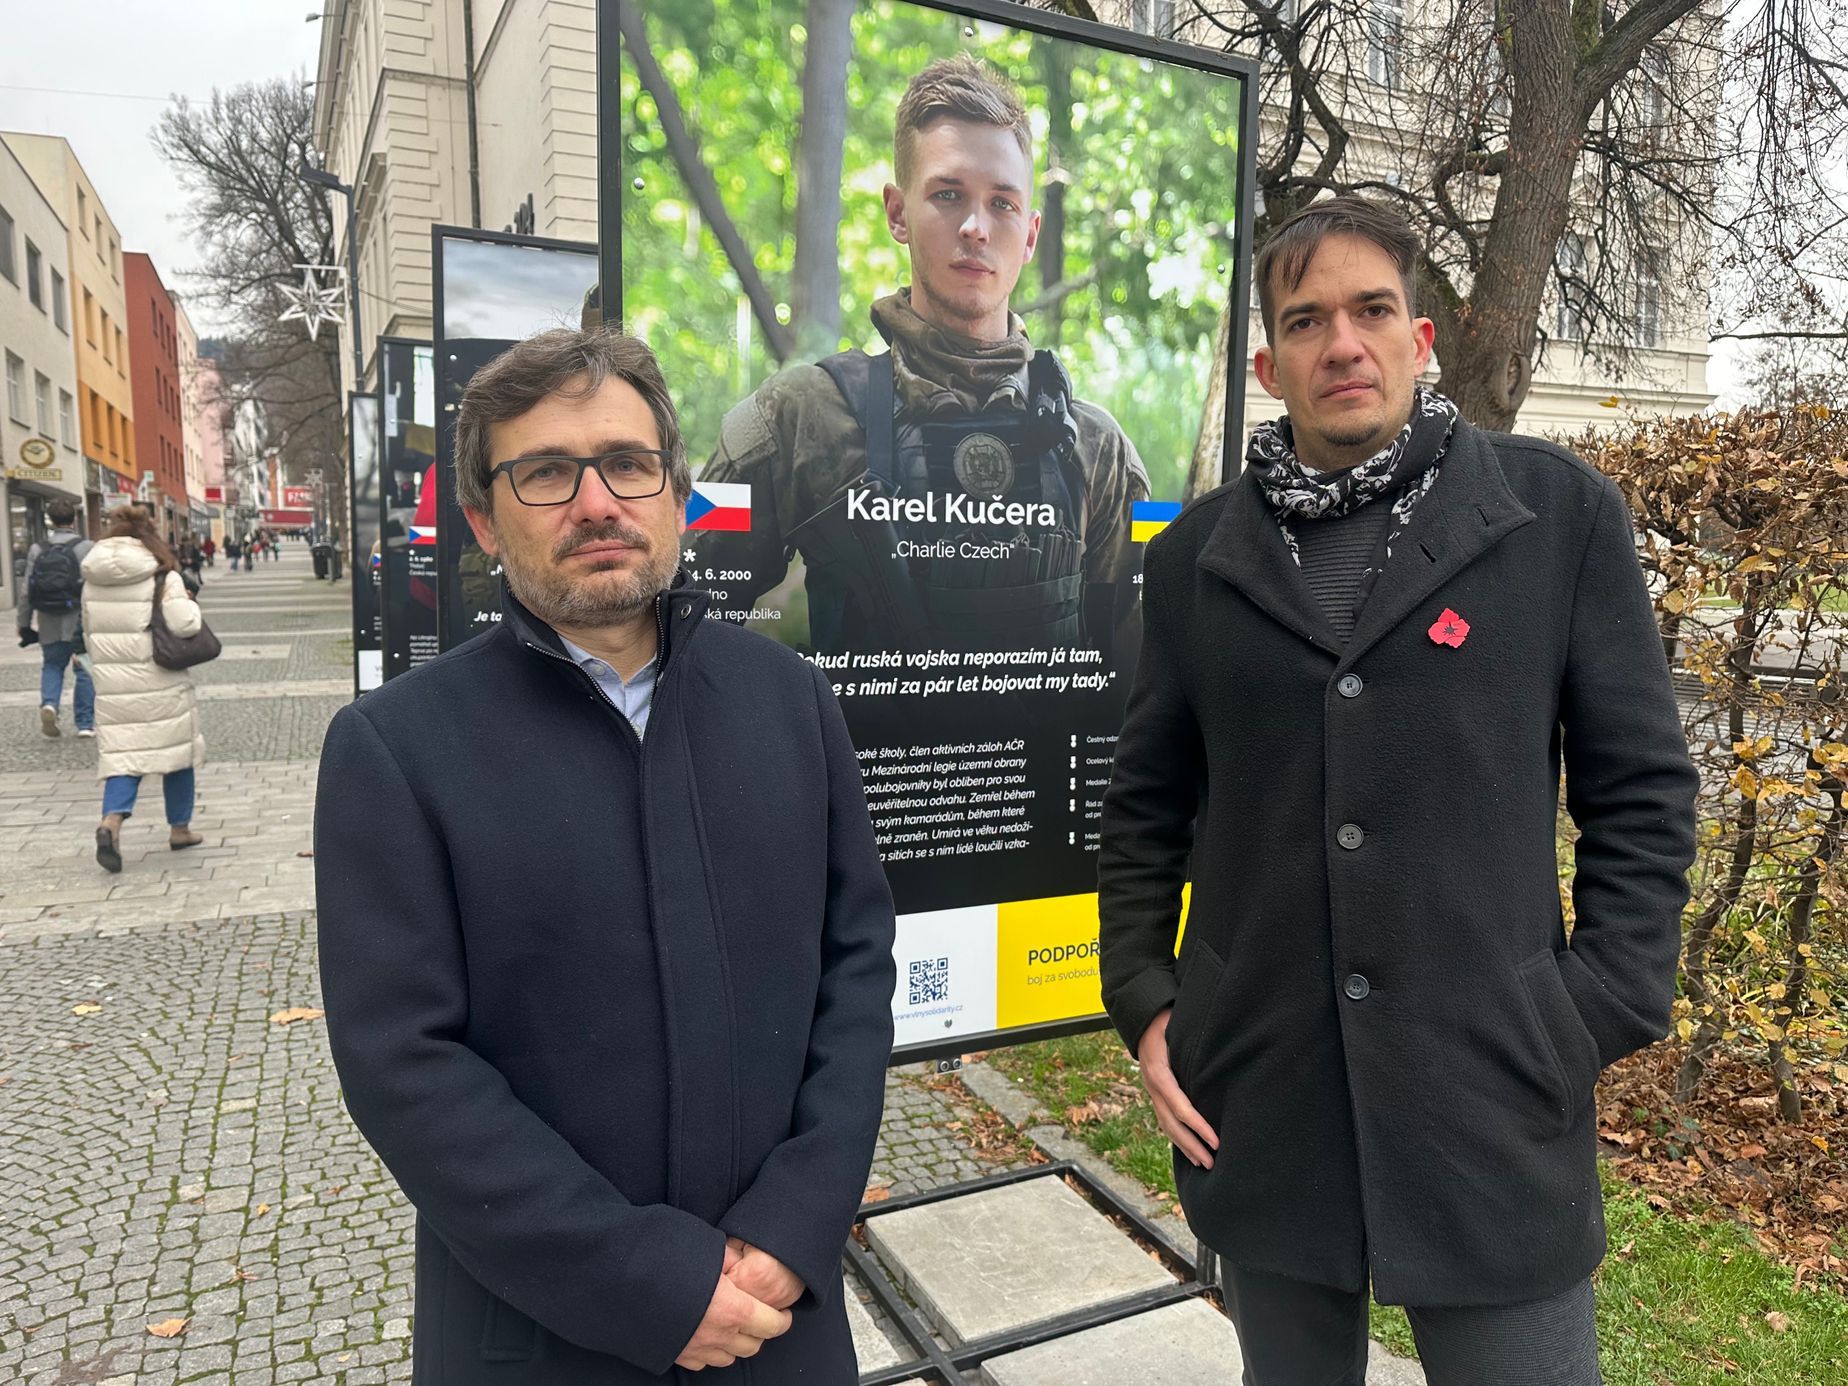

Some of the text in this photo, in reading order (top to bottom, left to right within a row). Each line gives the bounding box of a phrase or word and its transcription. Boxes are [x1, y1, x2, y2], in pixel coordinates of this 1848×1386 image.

[847, 488, 1057, 527] Karel Kučera
[891, 539, 1015, 560] „Charlie Czech“
[705, 568, 717, 581] 6.
[719, 570, 752, 581] 2000
[708, 588, 728, 600] no
[473, 610, 503, 622] Je to
[705, 607, 782, 623] ká republika
[852, 650, 903, 669] ruská
[906, 649, 960, 670] vojska
[963, 647, 1048, 669] neporazím
[1047, 647, 1066, 667] já
[1069, 647, 1103, 665] tam,
[845, 683, 856, 696] s
[859, 677, 899, 696] nimi
[899, 681, 921, 694] za
[922, 676, 955, 698] pár
[956, 675, 980, 692] let
[981, 673, 1043, 694] bojovat
[1045, 676, 1070, 693] my
[1071, 671, 1117, 691] tady.“
[909, 745, 930, 757] člen
[931, 743, 976, 756] aktivních
[976, 741, 1003, 753] záloh
[1003, 738, 1025, 751] AČR
[871, 761, 933, 776] Mezinárodní
[933, 760, 957, 774] legie
[958, 757, 993, 771] územní
[994, 757, 1028, 769] obrany
[863, 774, 1027, 795] polubojovníky byl oblíben pro svou
[867, 789, 1036, 811] euvěřitelnou odvahu. Zemřel během
[875, 816, 902, 829] svým
[967, 808, 1001, 820] během
[1001, 805, 1027, 817] které
[875, 820, 1034, 845] lně zraněn. Umírá ve věku nedoži-
[914, 849, 927, 858] se
[928, 848, 935, 857] s
[936, 844, 955, 856] ním
[956, 841, 975, 854] lidé
[975, 840, 1004, 853] loučili
[1004, 838, 1031, 849] vzka-
[1027, 973, 1044, 986] boj
[1045, 973, 1057, 984] za
